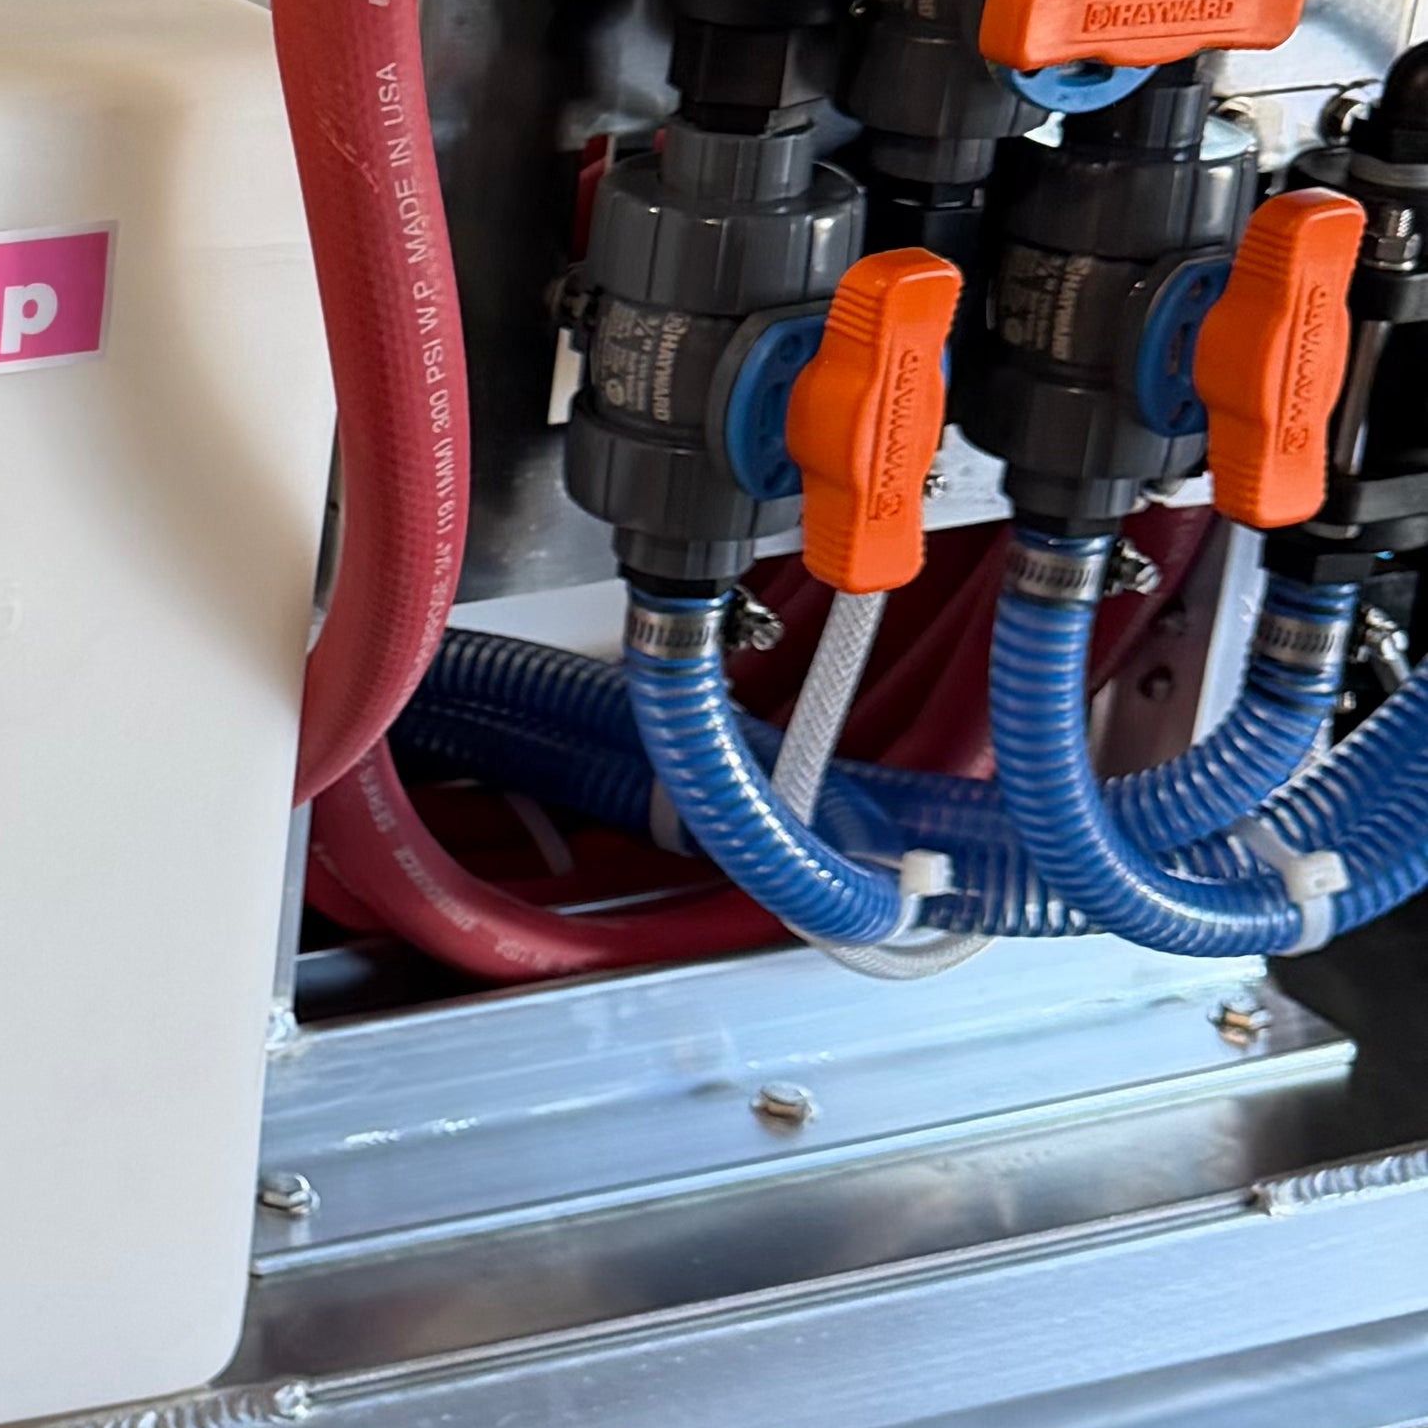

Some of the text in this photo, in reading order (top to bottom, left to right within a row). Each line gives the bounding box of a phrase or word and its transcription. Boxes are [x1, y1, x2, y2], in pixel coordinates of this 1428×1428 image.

[375, 61, 406, 128] USA
[387, 134, 413, 168] IN
[394, 176, 431, 265] MADE
[422, 338, 446, 386] PSI
[651, 331, 683, 422] HAYWARD
[429, 388, 450, 435] 300
